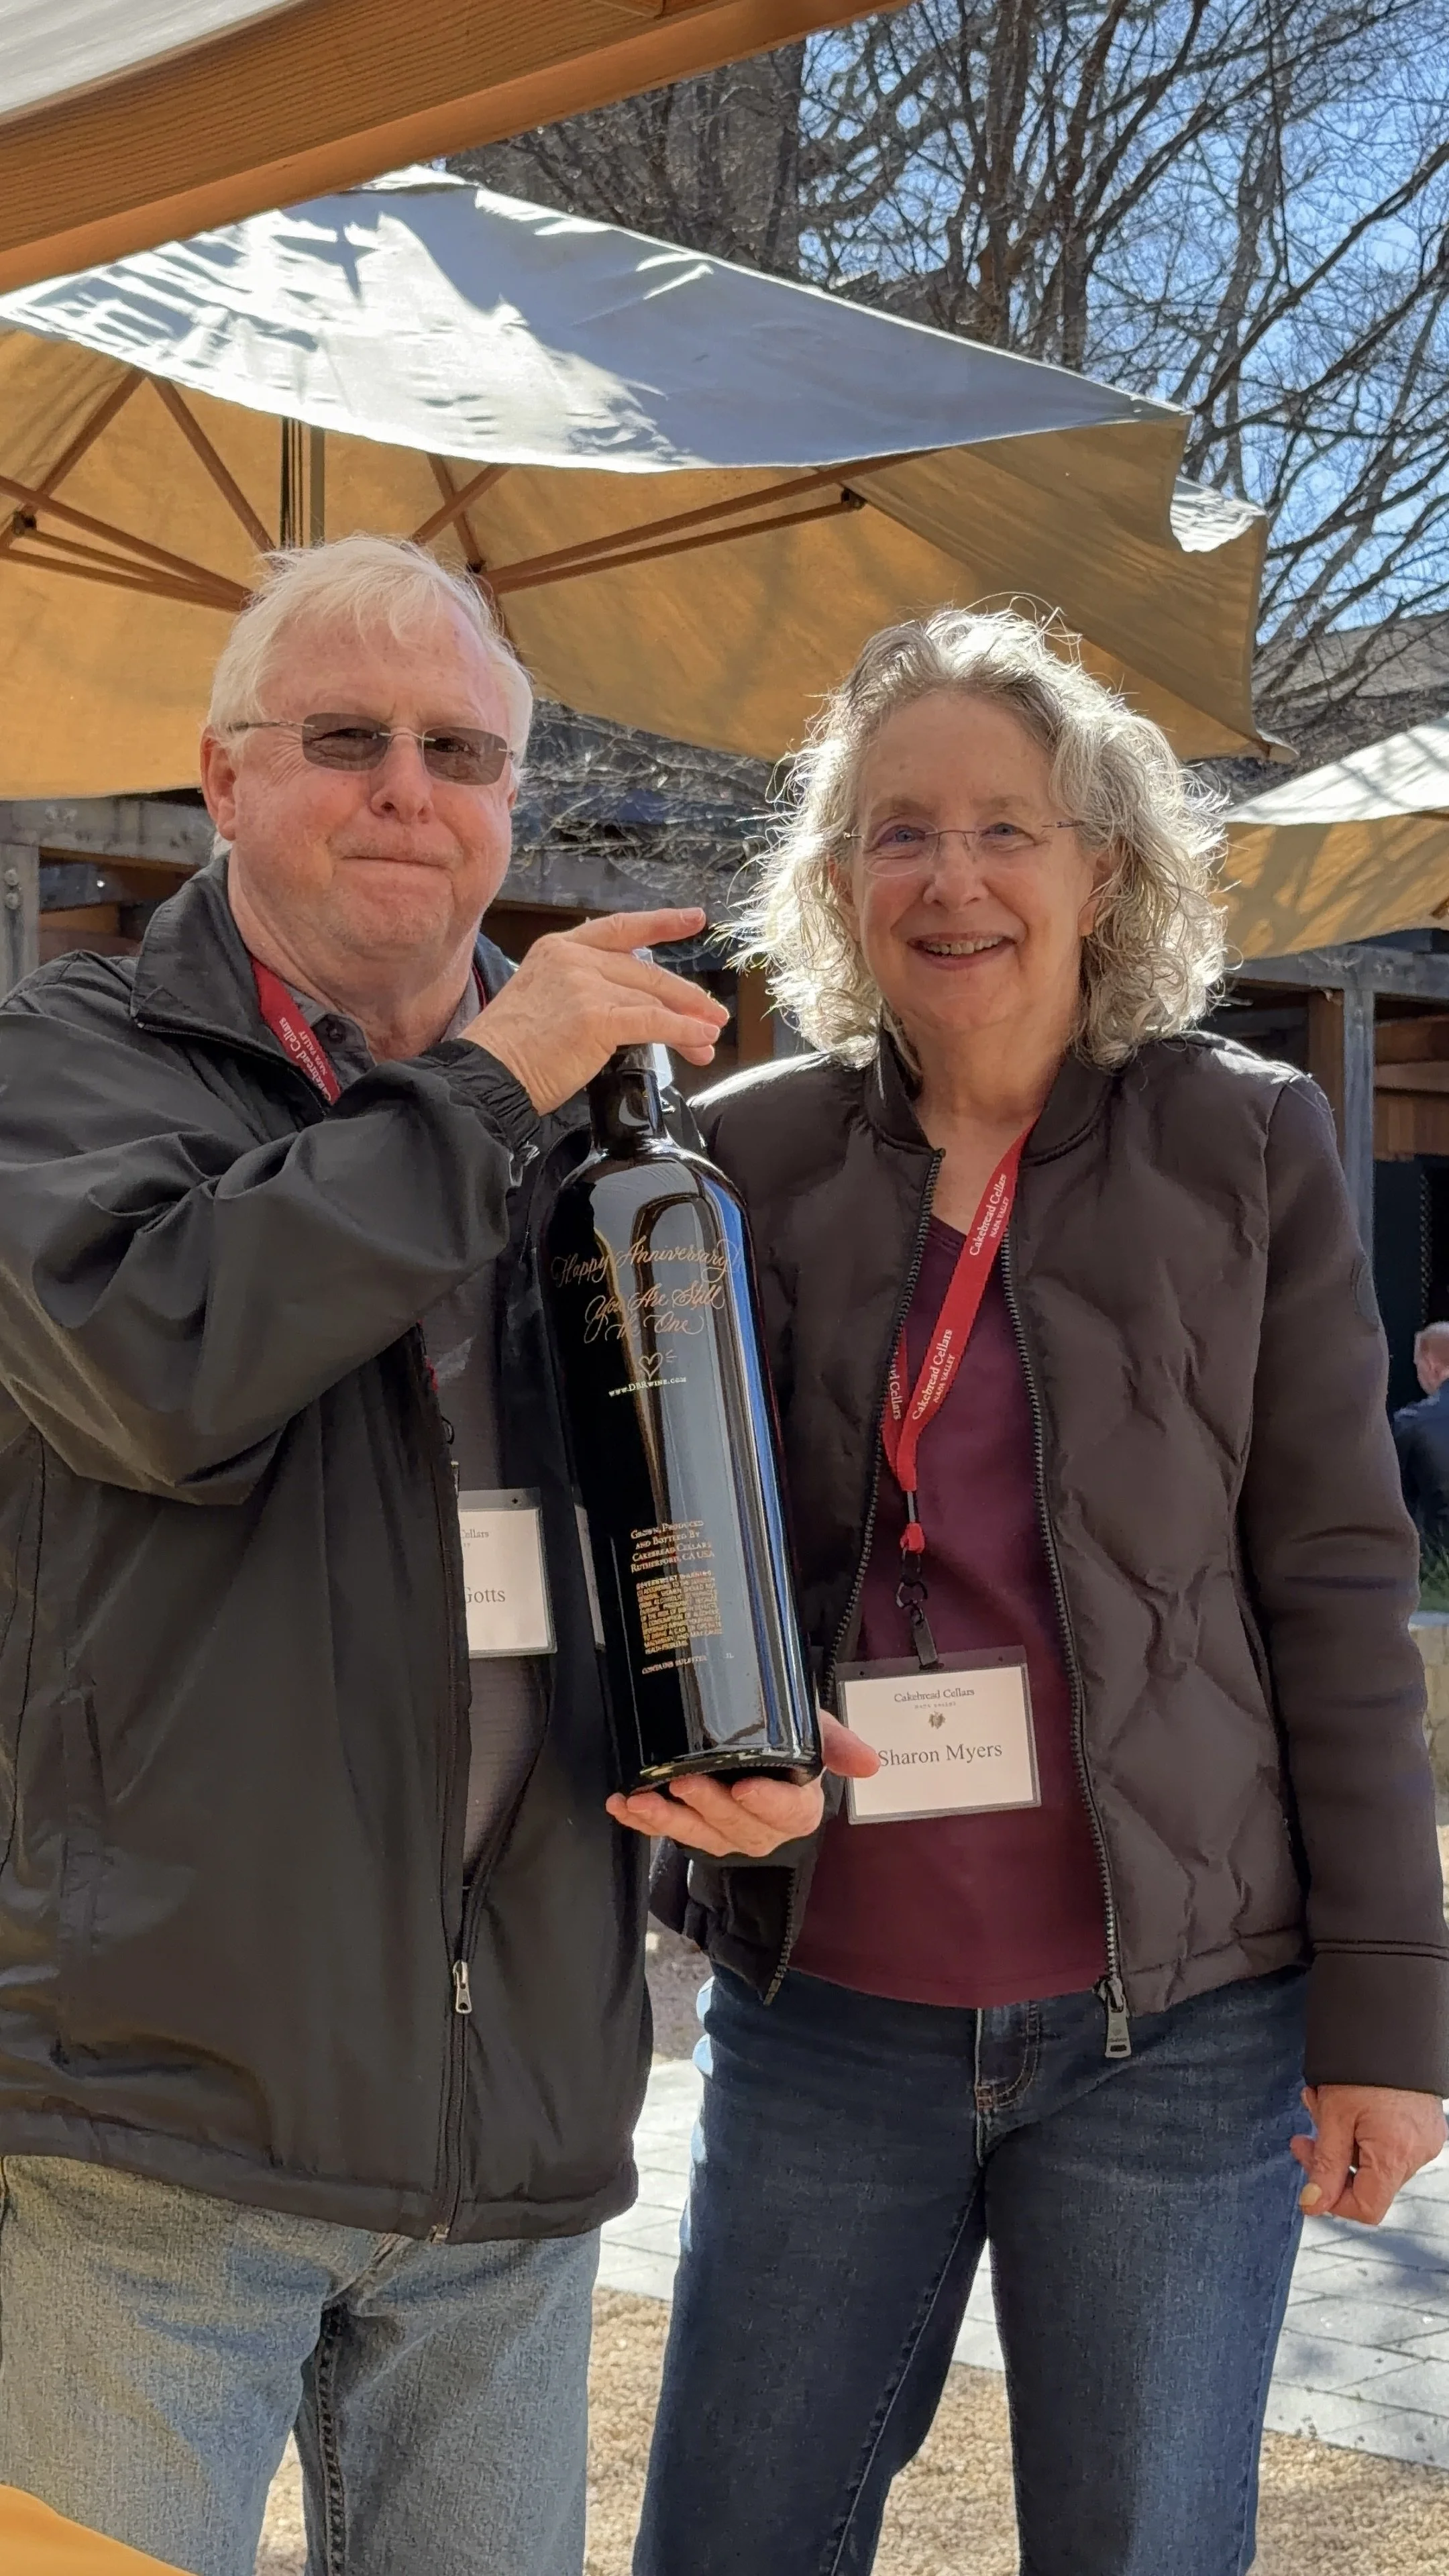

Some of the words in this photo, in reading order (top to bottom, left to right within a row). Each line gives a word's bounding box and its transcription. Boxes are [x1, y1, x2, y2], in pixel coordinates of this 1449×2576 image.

[279, 1017, 301, 1051] Cellars
[299, 1031, 317, 1055] VALLEY
[315, 1055, 327, 1075] NAPA
[969, 1204, 996, 1255] Cakebread
[989, 1173, 1006, 1204] Cellars
[989, 1220, 1002, 1238] NAPA
[996, 1196, 1009, 1219] VALLEY
[551, 1252, 610, 1288] Happy
[616, 1235, 739, 1283] Anniversary
[584, 1295, 624, 1343] You
[627, 1283, 669, 1311] Are
[672, 1279, 725, 1309] Still
[643, 1311, 704, 1335] One
[912, 1366, 940, 1419] Cakebread
[933, 1329, 953, 1365] Cellars
[933, 1383, 945, 1403] NAPA
[941, 1354, 955, 1381] VALLEY
[890, 1381, 903, 1420] Cellars
[696, 1550, 715, 1559] USA
[894, 1689, 940, 1703] Cakebread
[943, 1687, 975, 1698] Cellars
[877, 1749, 940, 1766] Sharon
[946, 1743, 1002, 1763] Myers
